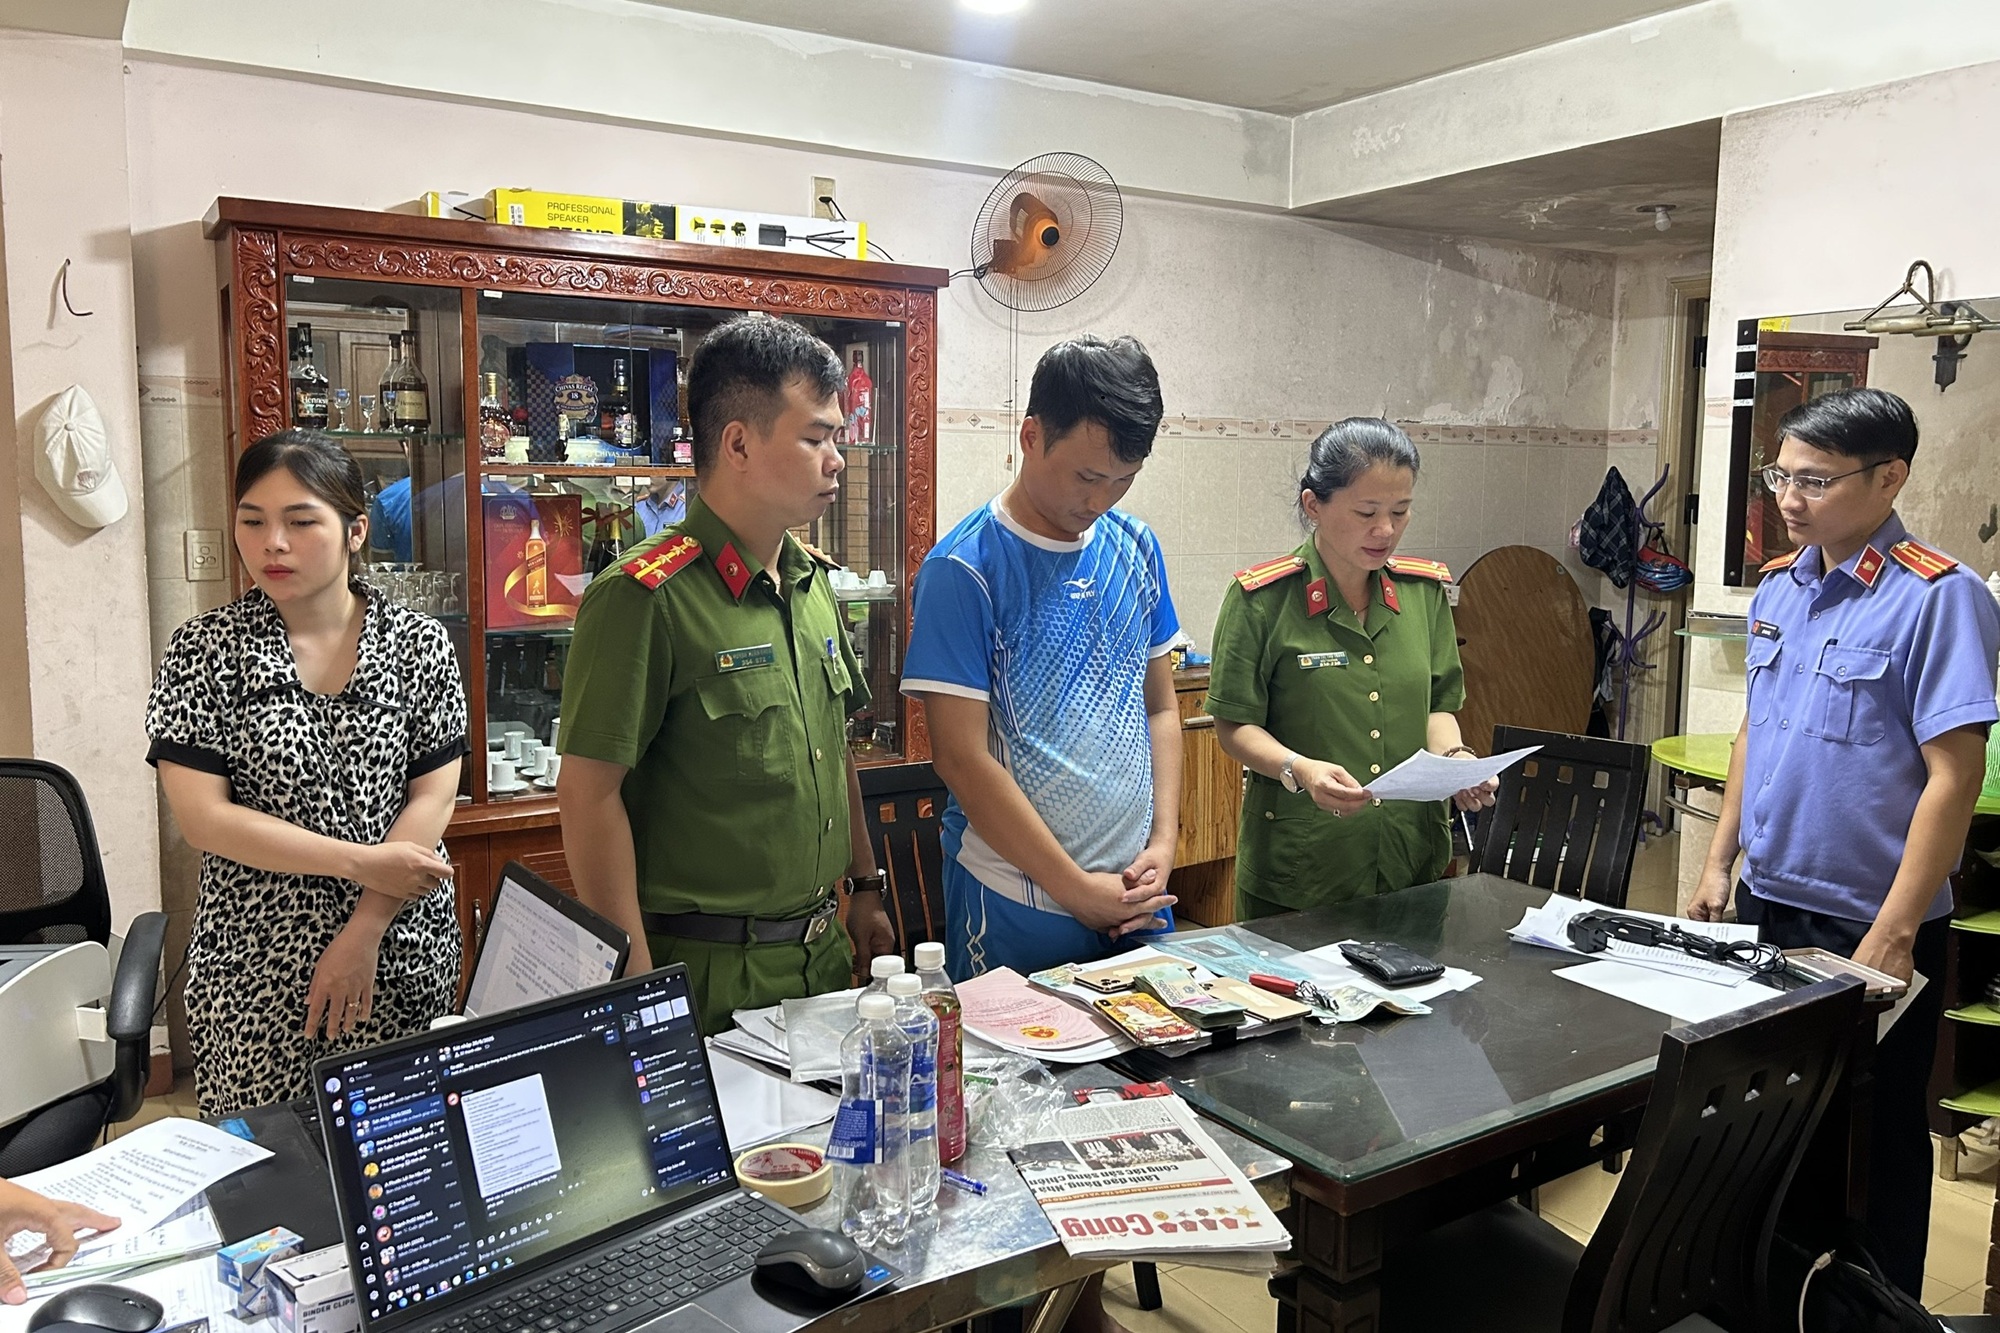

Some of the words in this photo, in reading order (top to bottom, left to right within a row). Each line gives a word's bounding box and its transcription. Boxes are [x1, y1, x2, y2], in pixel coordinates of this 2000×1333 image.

[547, 202, 616, 216] PROFESSIONAL
[547, 213, 589, 224] SPEAKER
[555, 384, 575, 393] CHIVAS
[576, 384, 594, 393] REGAL
[594, 450, 620, 458] CHIVAS
[1125, 1167, 1147, 1176] tác
[1146, 1163, 1179, 1174] công
[1067, 1171, 1100, 1182] sàng
[1103, 1176, 1128, 1187] đạo
[1060, 1213, 1154, 1239] Công
[303, 1304, 332, 1318] BINDER
[333, 1298, 356, 1310] CLIPS
